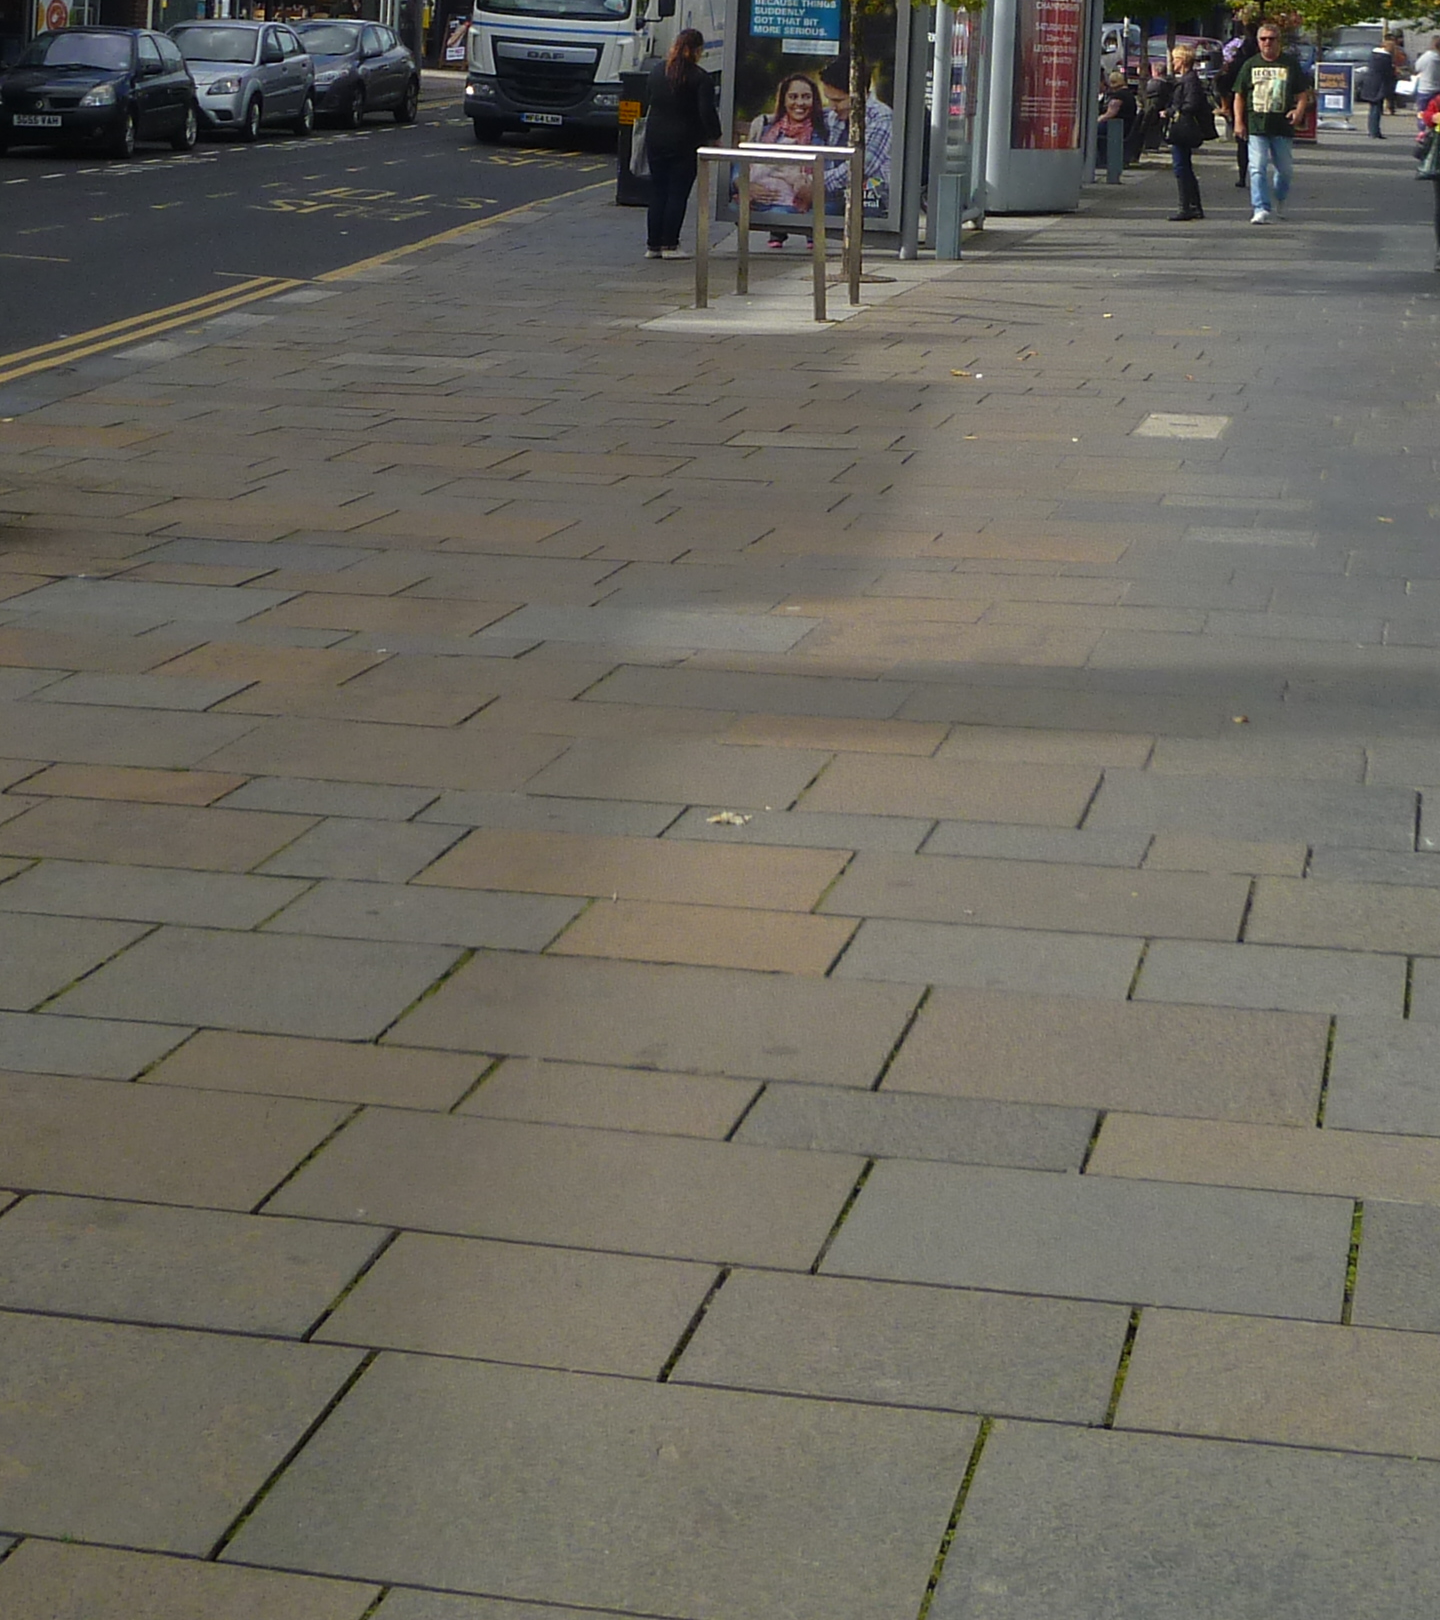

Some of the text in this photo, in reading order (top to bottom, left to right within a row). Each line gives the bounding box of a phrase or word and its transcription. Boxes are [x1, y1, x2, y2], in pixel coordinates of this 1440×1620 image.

[802, 0, 837, 9] THINGS
[754, 7, 806, 17] SUDDENLY
[753, 16, 819, 27] GOT THAT BIT
[753, 25, 828, 37] MORE SERIOUS.
[527, 50, 564, 61] DAF
